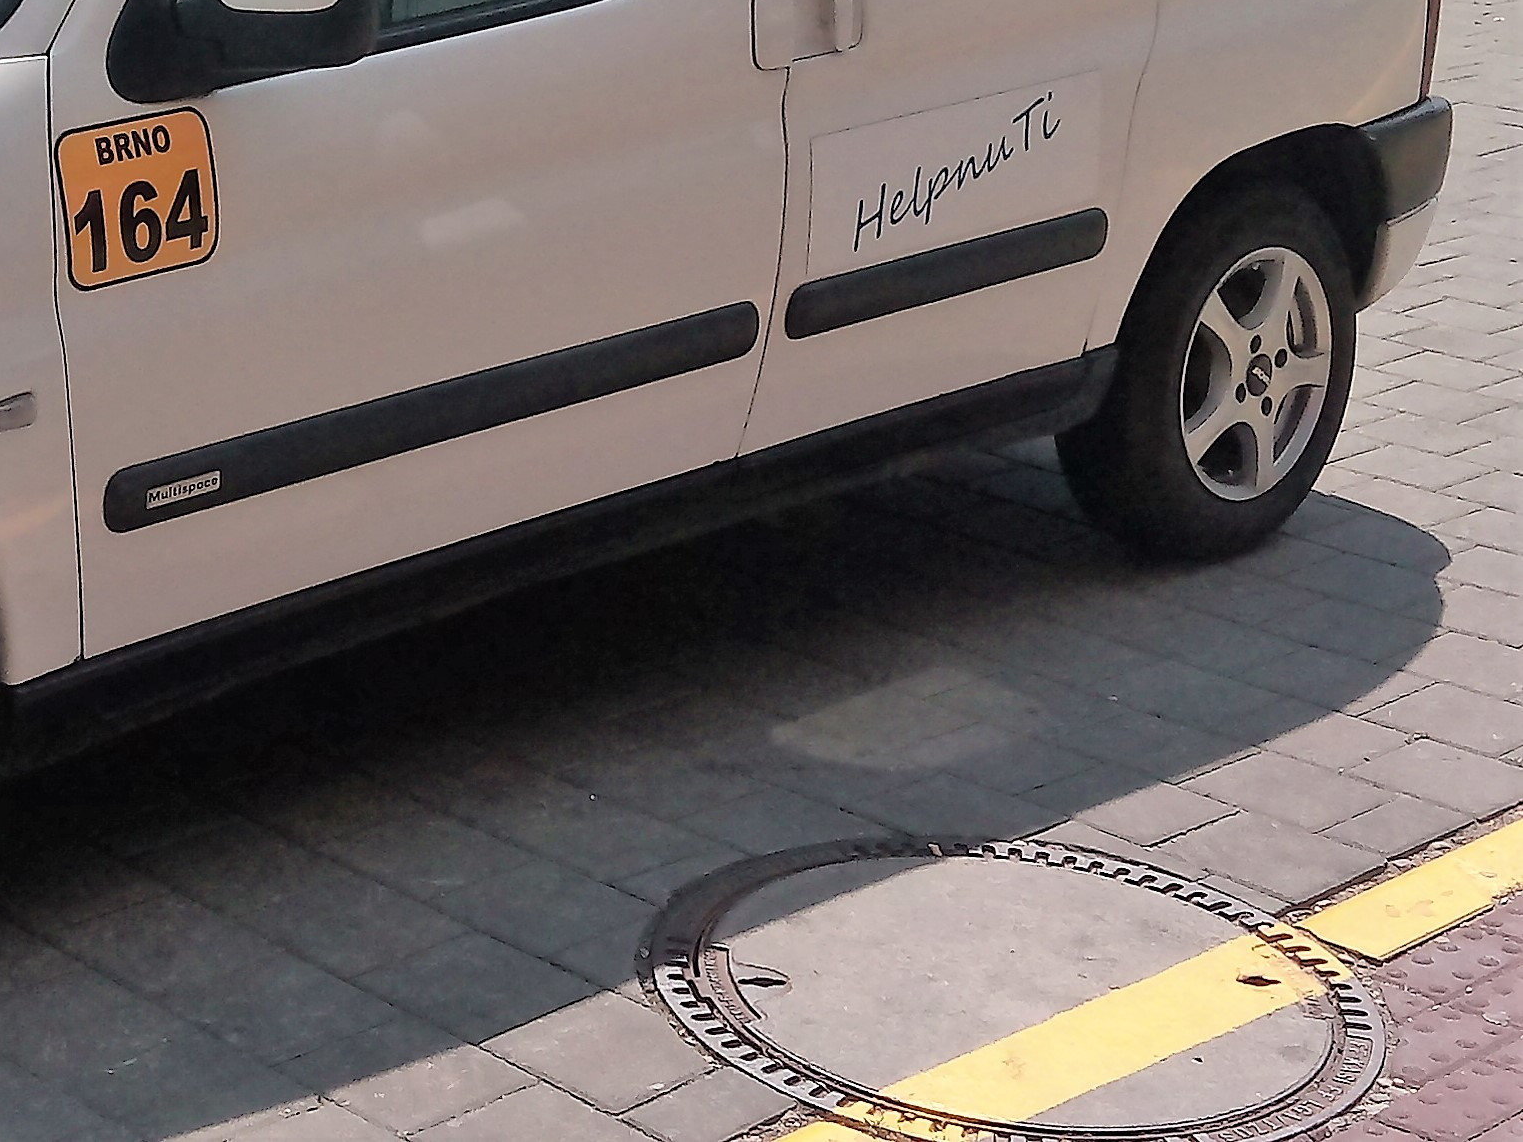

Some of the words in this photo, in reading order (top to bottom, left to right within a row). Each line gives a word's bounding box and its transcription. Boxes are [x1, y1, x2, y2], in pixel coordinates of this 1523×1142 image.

[94, 125, 172, 166] BRNO
[73, 168, 209, 273] 164
[148, 476, 219, 503] Multispace
